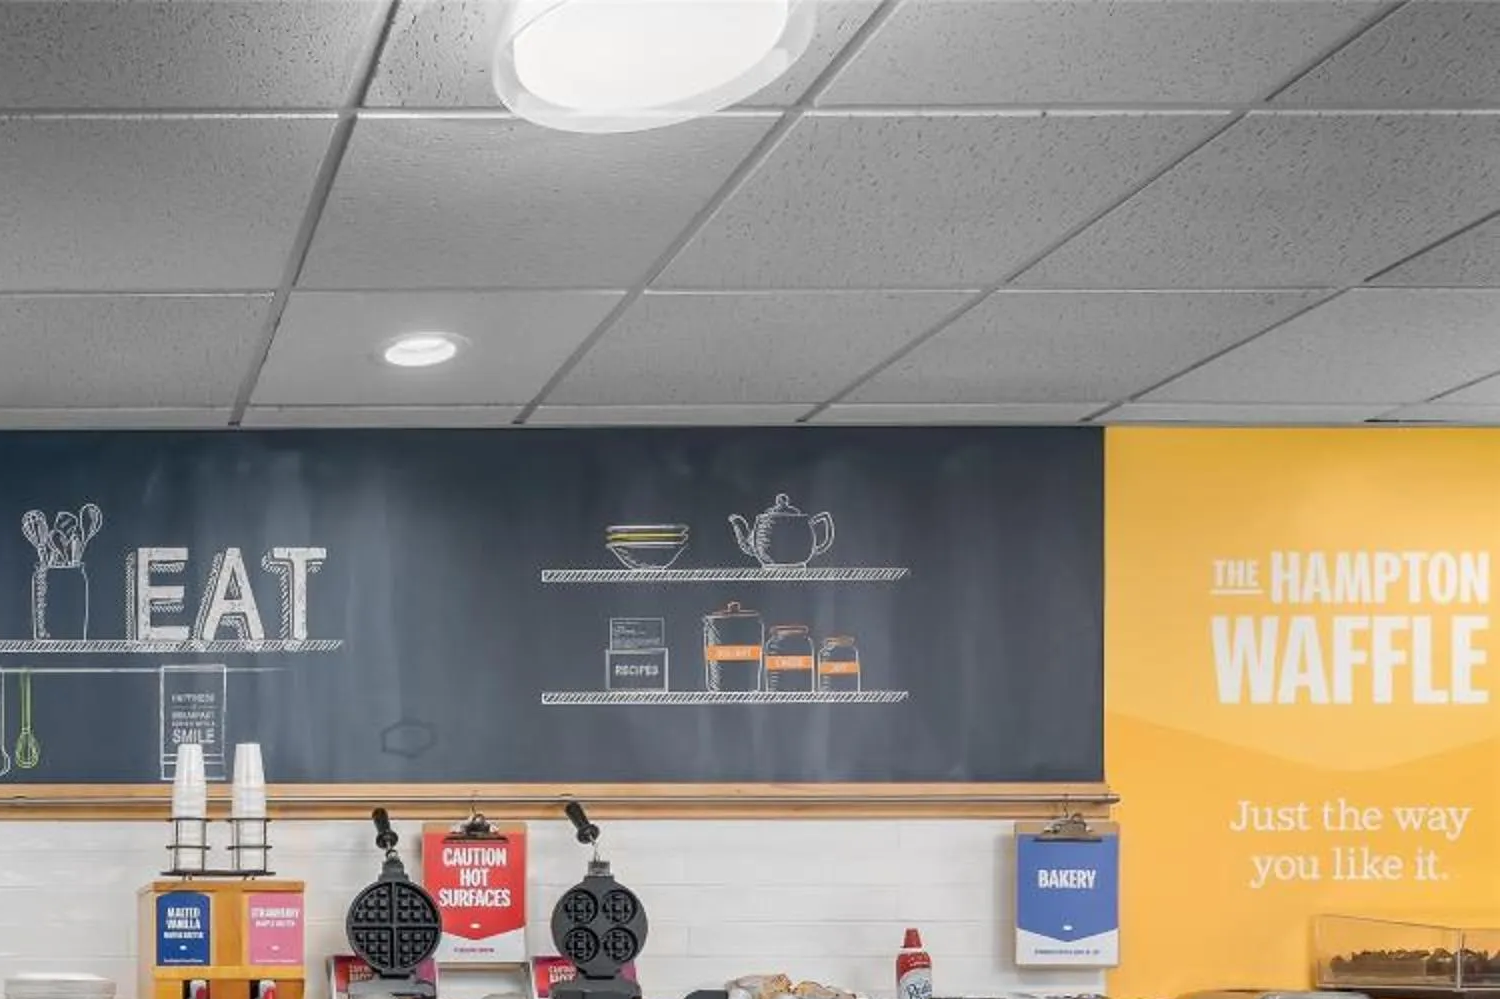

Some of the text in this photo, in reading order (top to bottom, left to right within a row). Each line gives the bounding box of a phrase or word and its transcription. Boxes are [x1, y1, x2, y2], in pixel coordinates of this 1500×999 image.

[1211, 550, 1491, 604] THE HAMPTON
[126, 547, 327, 643] EAT
[1210, 614, 1491, 705] WAFFLE
[171, 727, 216, 744] SMILE
[1229, 798, 1473, 841] Just the way
[442, 847, 507, 868] CAUTION
[1249, 846, 1450, 890] you like it.
[459, 867, 490, 888] HOT
[1037, 868, 1098, 890] BAKERY
[438, 887, 512, 908] SURFACES
[165, 918, 201, 929] VANILLA
